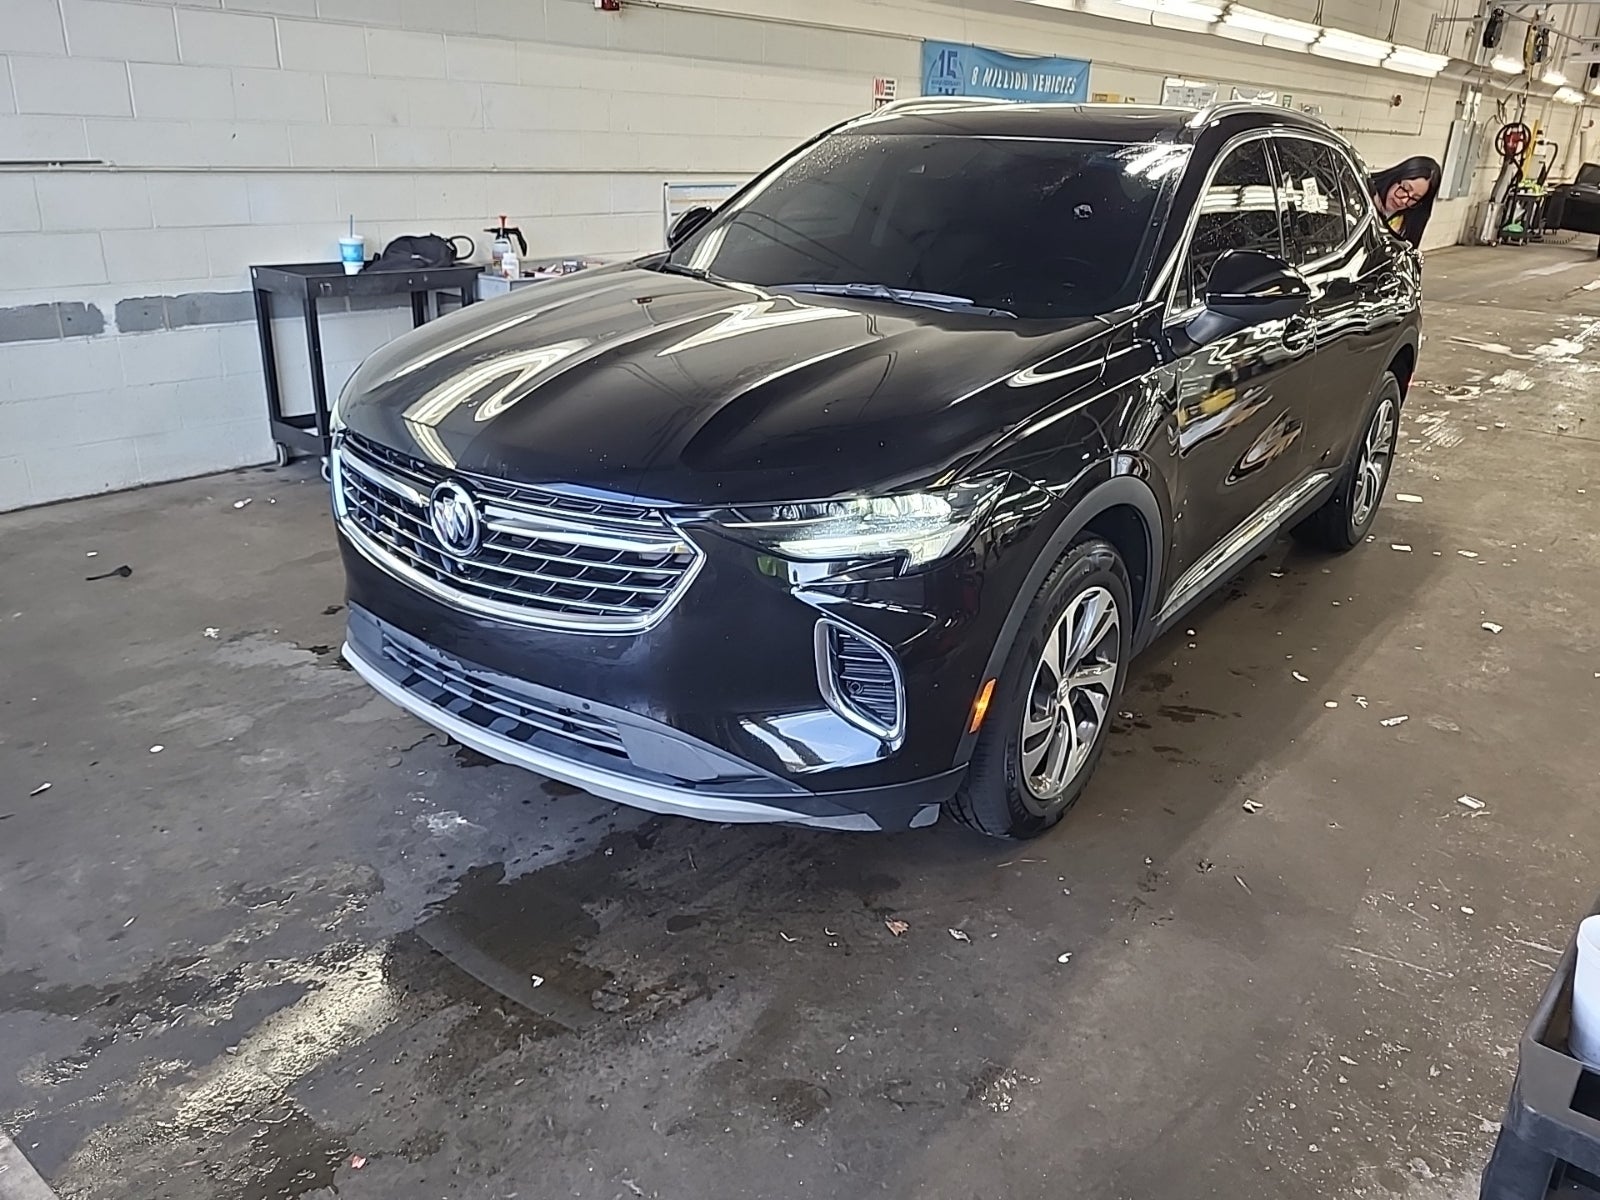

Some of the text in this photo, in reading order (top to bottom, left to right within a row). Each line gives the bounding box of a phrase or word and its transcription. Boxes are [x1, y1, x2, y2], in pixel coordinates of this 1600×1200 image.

[939, 49, 958, 79] 15
[874, 79, 885, 96] NO
[971, 66, 1077, 95] 8 MILLION VEHICLES
